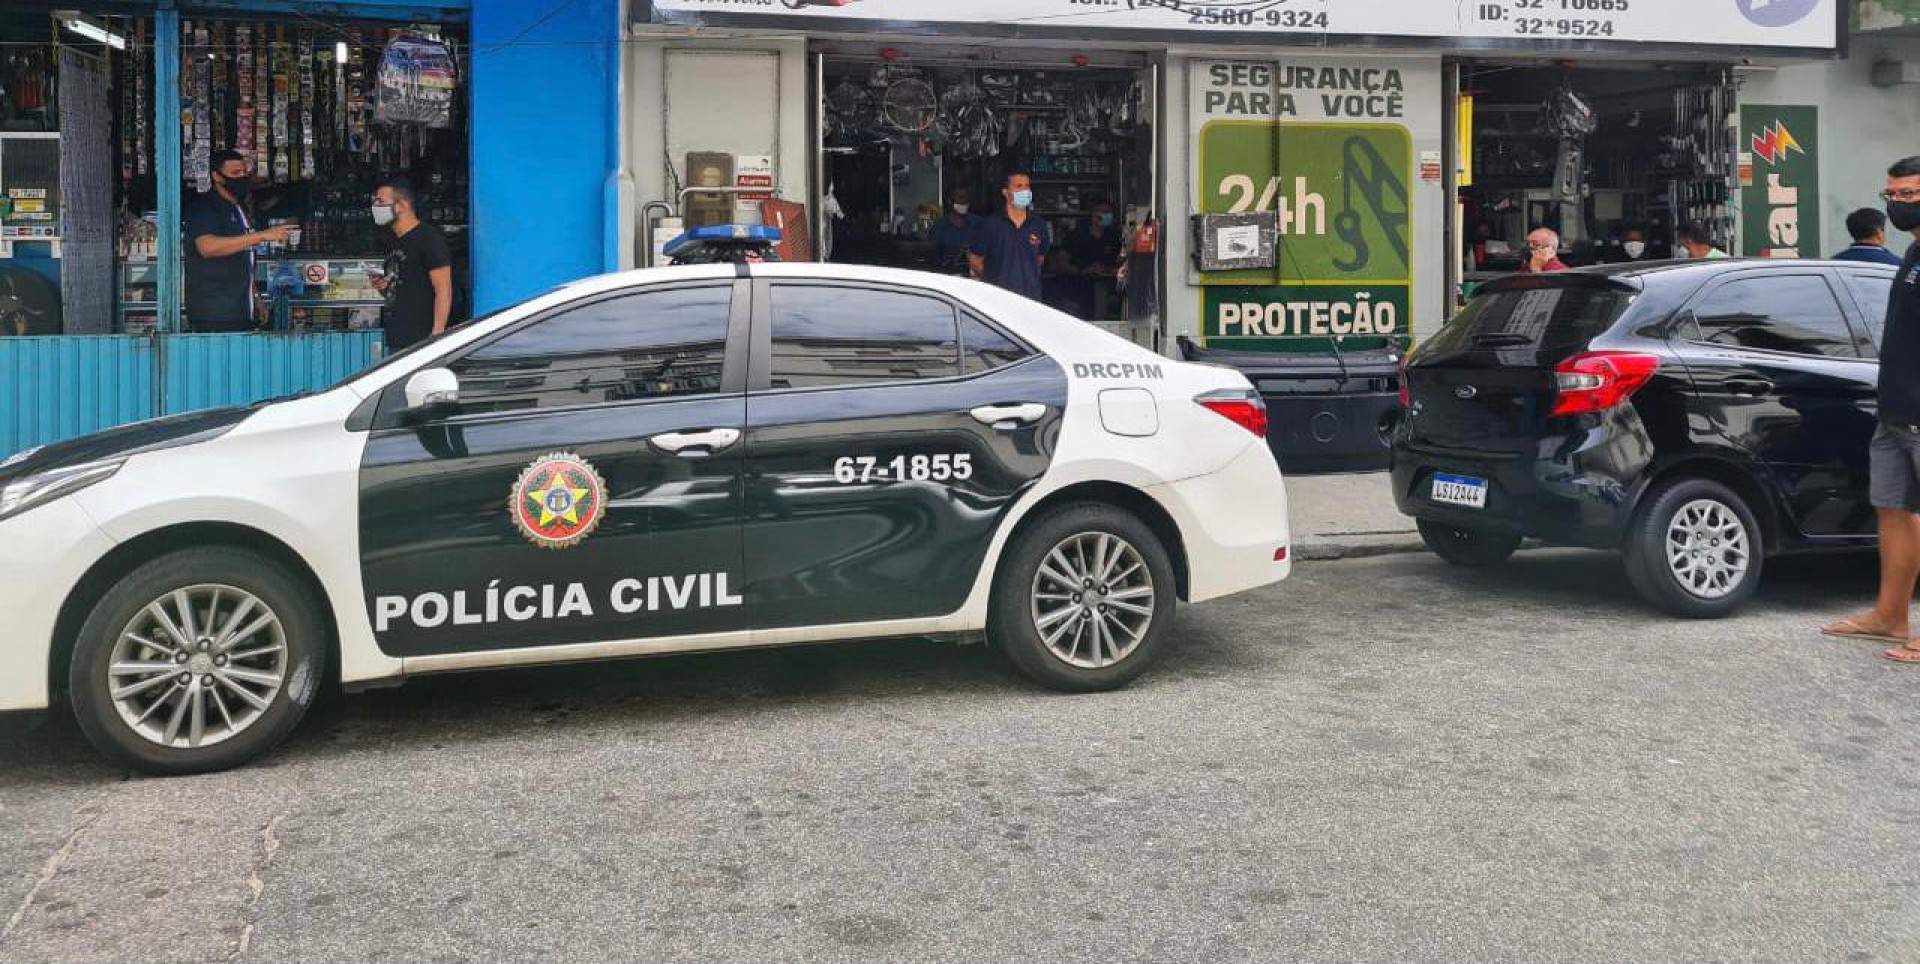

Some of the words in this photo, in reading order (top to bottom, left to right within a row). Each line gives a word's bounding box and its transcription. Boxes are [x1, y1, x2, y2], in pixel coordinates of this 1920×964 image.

[1187, 6, 1329, 28] 2580-9324
[1479, 4, 1509, 21] ID:
[1209, 63, 1404, 95] SEGURANÇA
[1205, 91, 1297, 116] PARA
[1321, 90, 1404, 118] VOCÊ
[1218, 174, 1326, 235] 24h
[1218, 291, 1397, 341] PROTEÇÃO
[1073, 363, 1164, 379] DRCPIM
[834, 453, 972, 484] 67-1855
[375, 579, 594, 632] POLÍCIA
[609, 572, 744, 614] CIVIL
